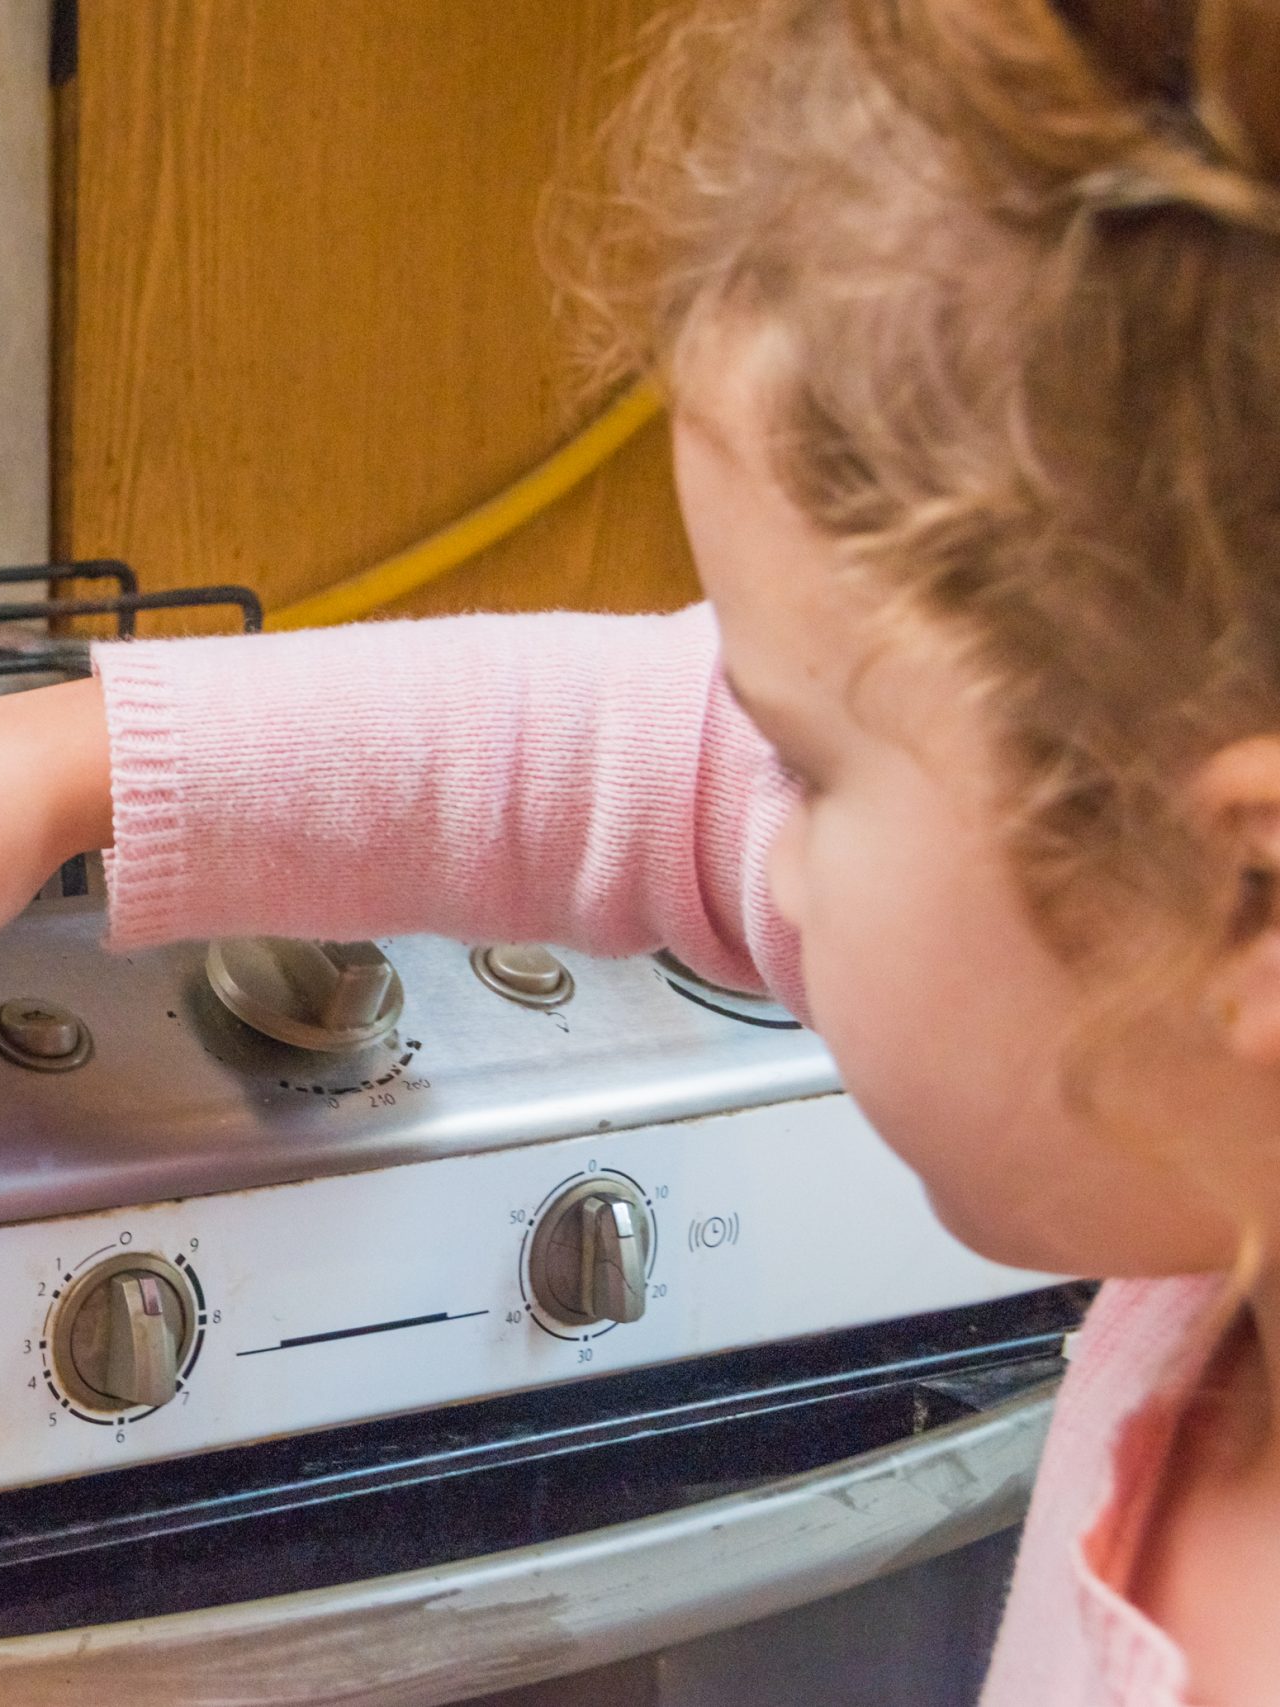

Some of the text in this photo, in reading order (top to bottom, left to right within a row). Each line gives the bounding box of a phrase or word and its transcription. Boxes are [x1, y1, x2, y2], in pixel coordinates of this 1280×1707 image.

[588, 1159, 597, 1173] 0
[655, 1185, 669, 1199] 10
[510, 1209, 526, 1225] 50
[190, 1238, 199, 1252] 9
[56, 1257, 62, 1271] 1
[38, 1283, 47, 1297] 2
[651, 1283, 668, 1298] 20
[213, 1310, 222, 1324] 8
[506, 1310, 521, 1324] 40
[23, 1339, 32, 1353] 3
[577, 1348, 593, 1363] 30
[27, 1375, 37, 1389] 4
[181, 1391, 191, 1405] 7
[48, 1412, 58, 1426] 5
[116, 1430, 126, 1443] 6
